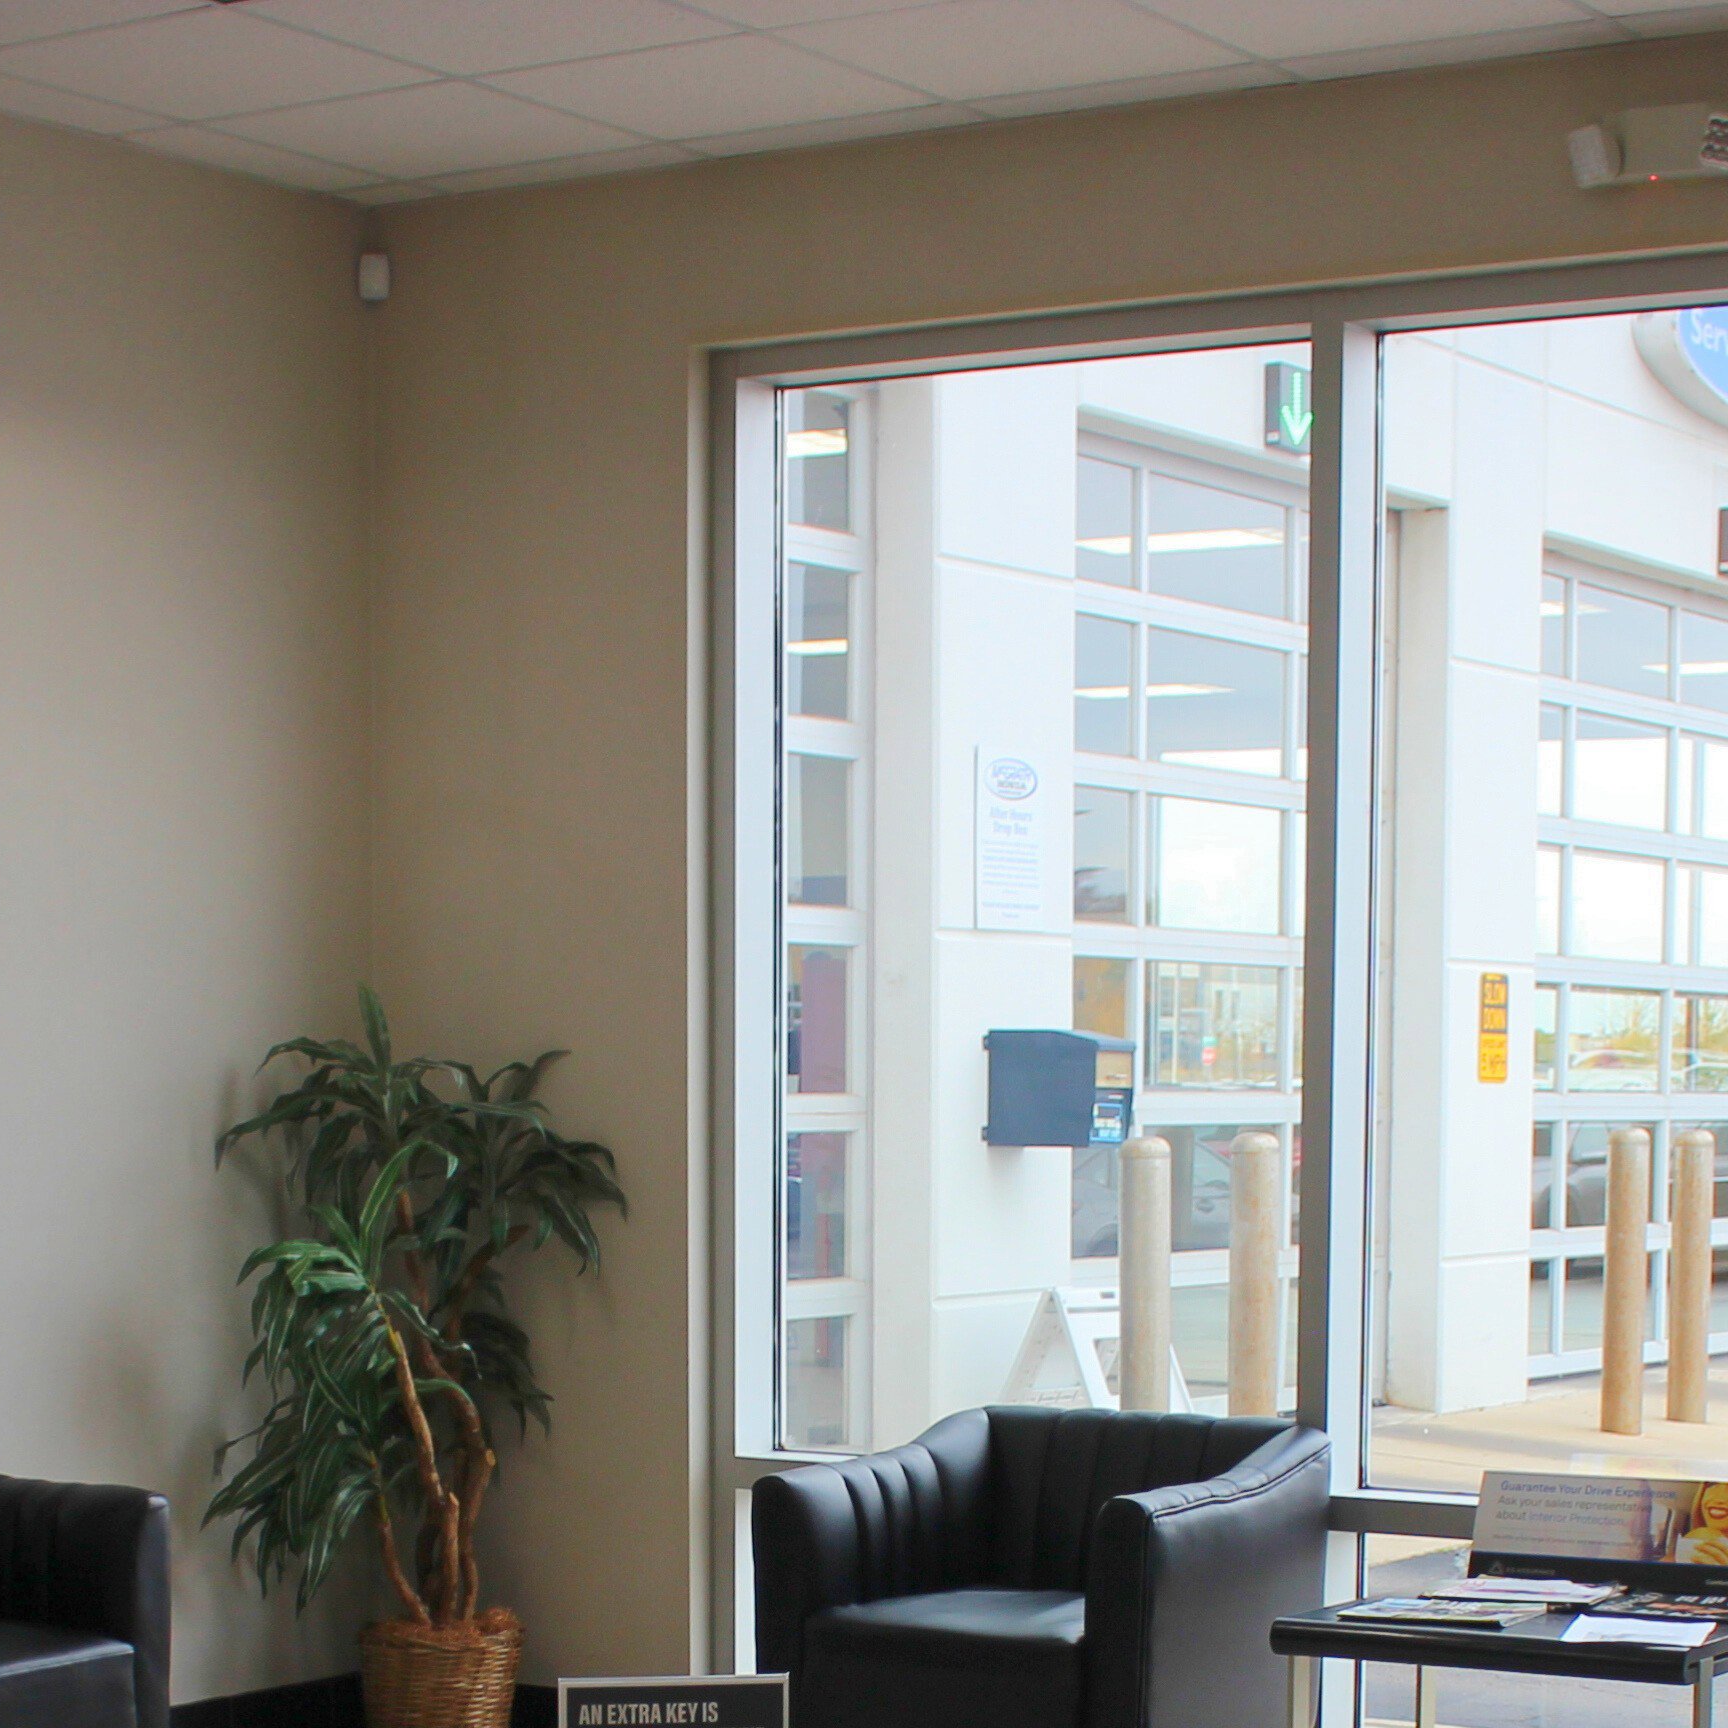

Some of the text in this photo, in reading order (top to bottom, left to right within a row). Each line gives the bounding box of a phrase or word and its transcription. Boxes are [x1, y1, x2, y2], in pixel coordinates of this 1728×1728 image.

[1501, 1480, 1677, 1499] Guarantee Your Drive Experience
[1497, 1496, 1517, 1504] Ask
[1518, 1497, 1541, 1507] your
[1544, 1499, 1572, 1508] sales
[1495, 1510, 1526, 1521] about
[1529, 1512, 1568, 1521] Interior
[579, 1702, 719, 1725] AN EXTRA KEY IS
